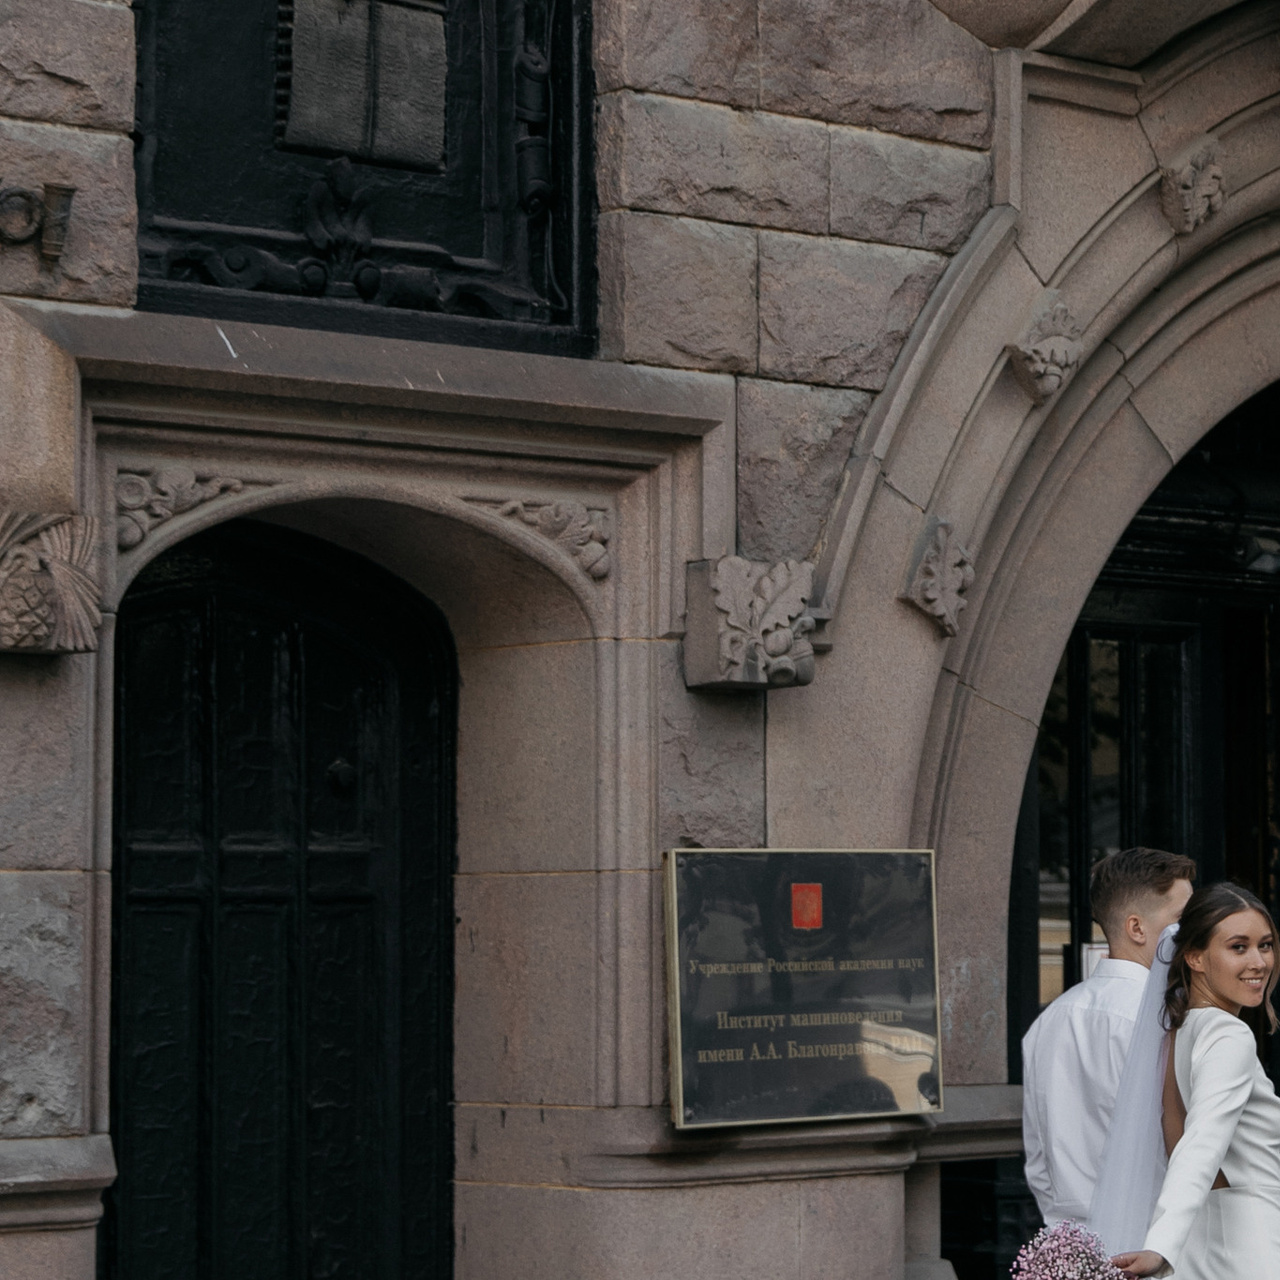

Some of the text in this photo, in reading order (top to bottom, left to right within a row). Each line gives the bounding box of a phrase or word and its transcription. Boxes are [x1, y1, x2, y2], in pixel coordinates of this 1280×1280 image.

[689, 958, 924, 978] Учреждение Российской академии наук
[717, 1010, 903, 1032] Институт машиноведения
[698, 1048, 744, 1063] имени
[750, 1042, 782, 1060] А.А.
